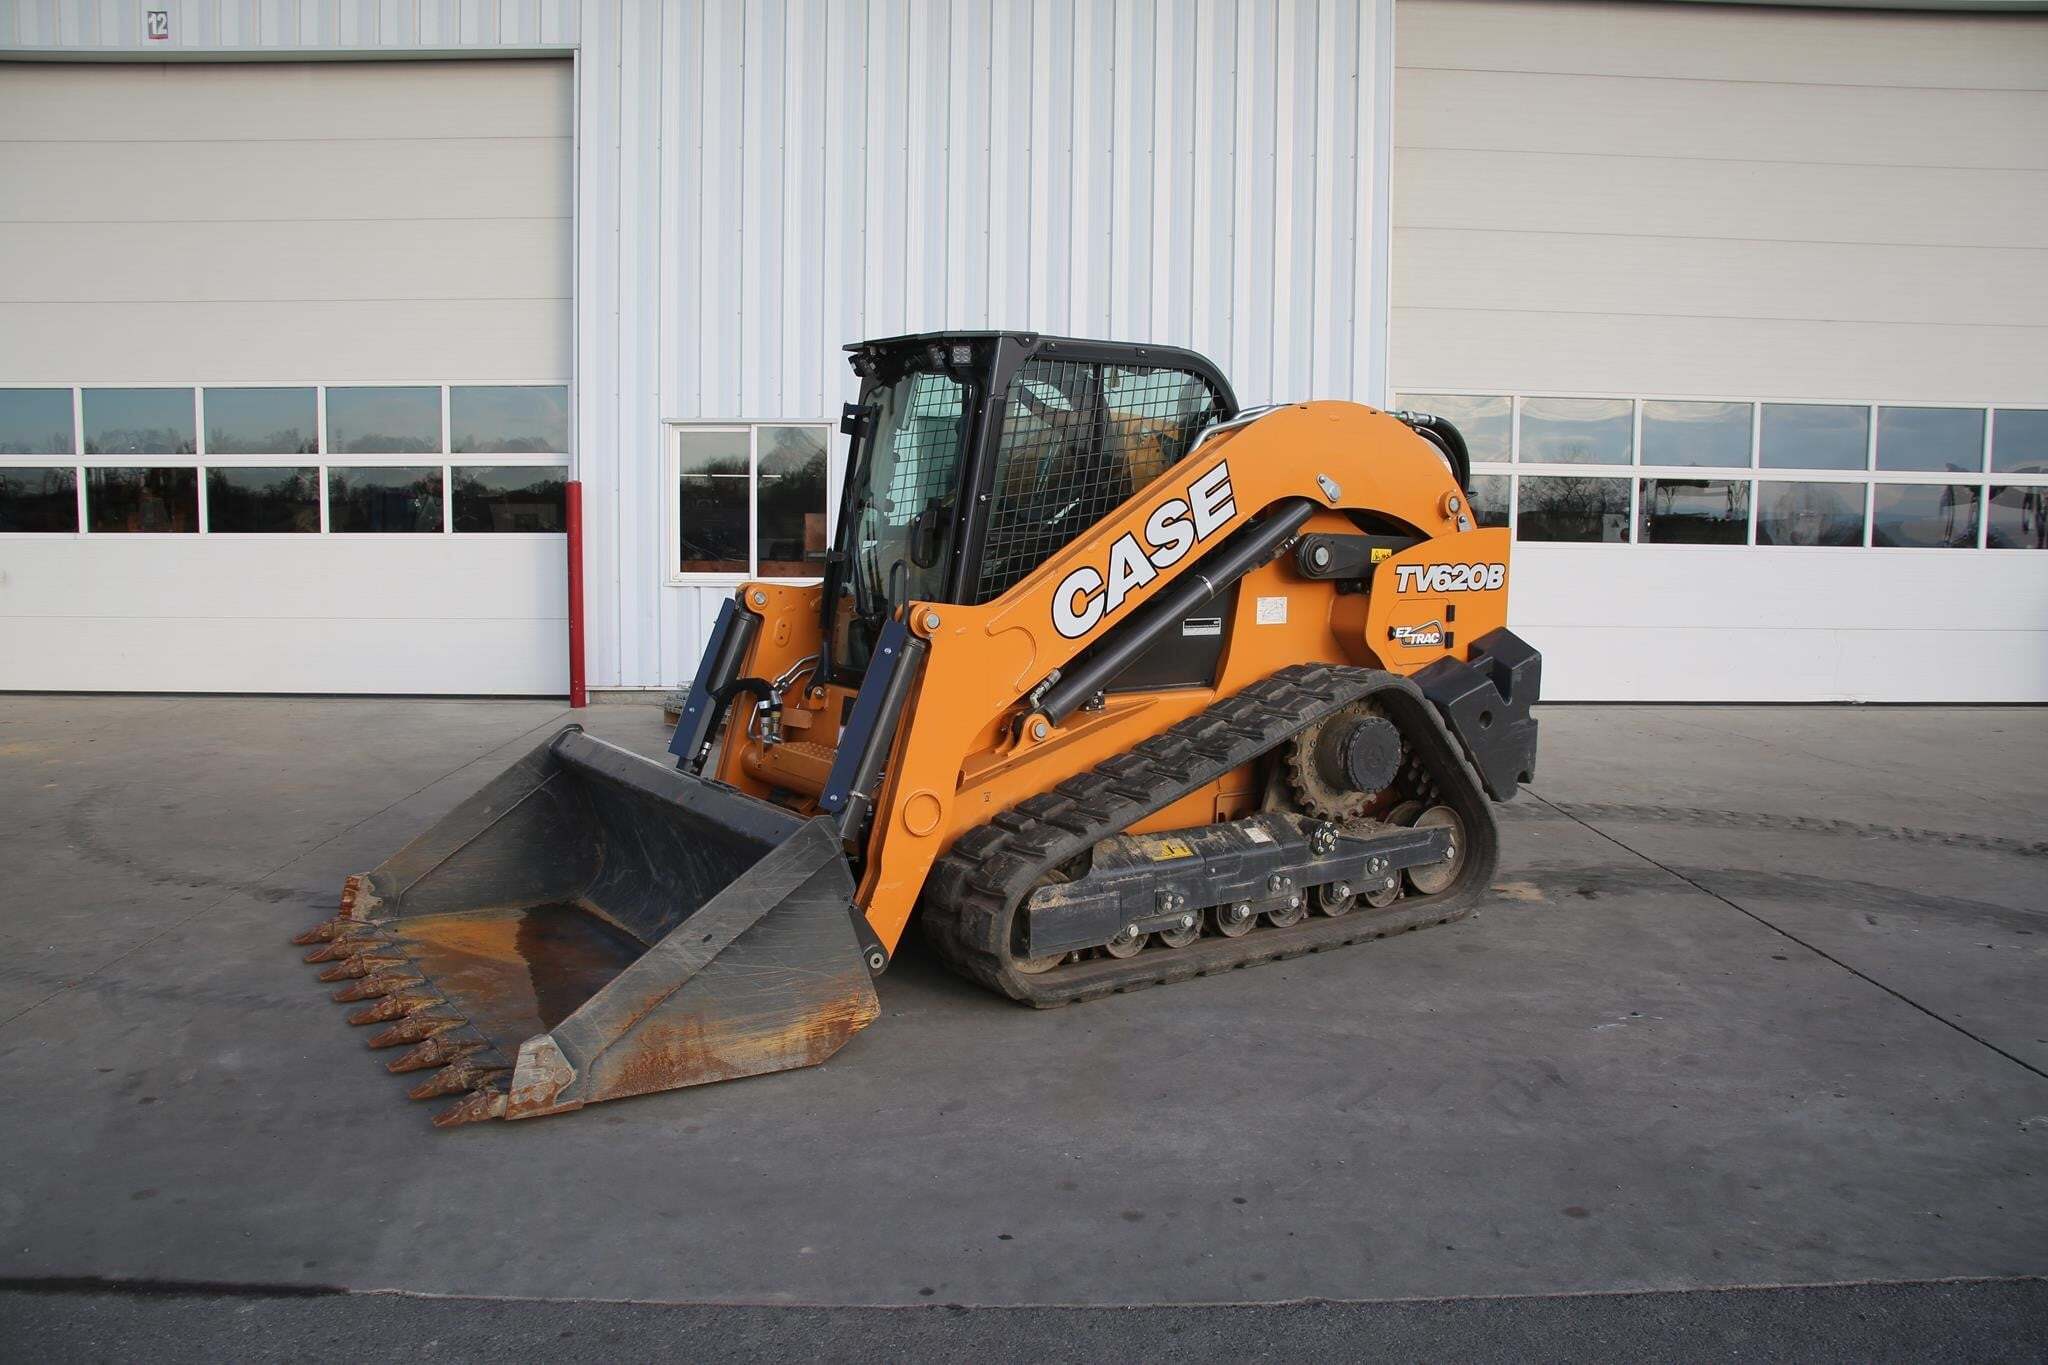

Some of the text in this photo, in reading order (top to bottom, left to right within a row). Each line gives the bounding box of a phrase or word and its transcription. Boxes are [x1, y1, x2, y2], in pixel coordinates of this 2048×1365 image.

[148, 13, 167, 35] 12
[1052, 458, 1237, 639] CASE
[1395, 563, 1505, 593] TV620B
[1395, 626, 1412, 638] EZ
[1410, 632, 1440, 645] TRAC
